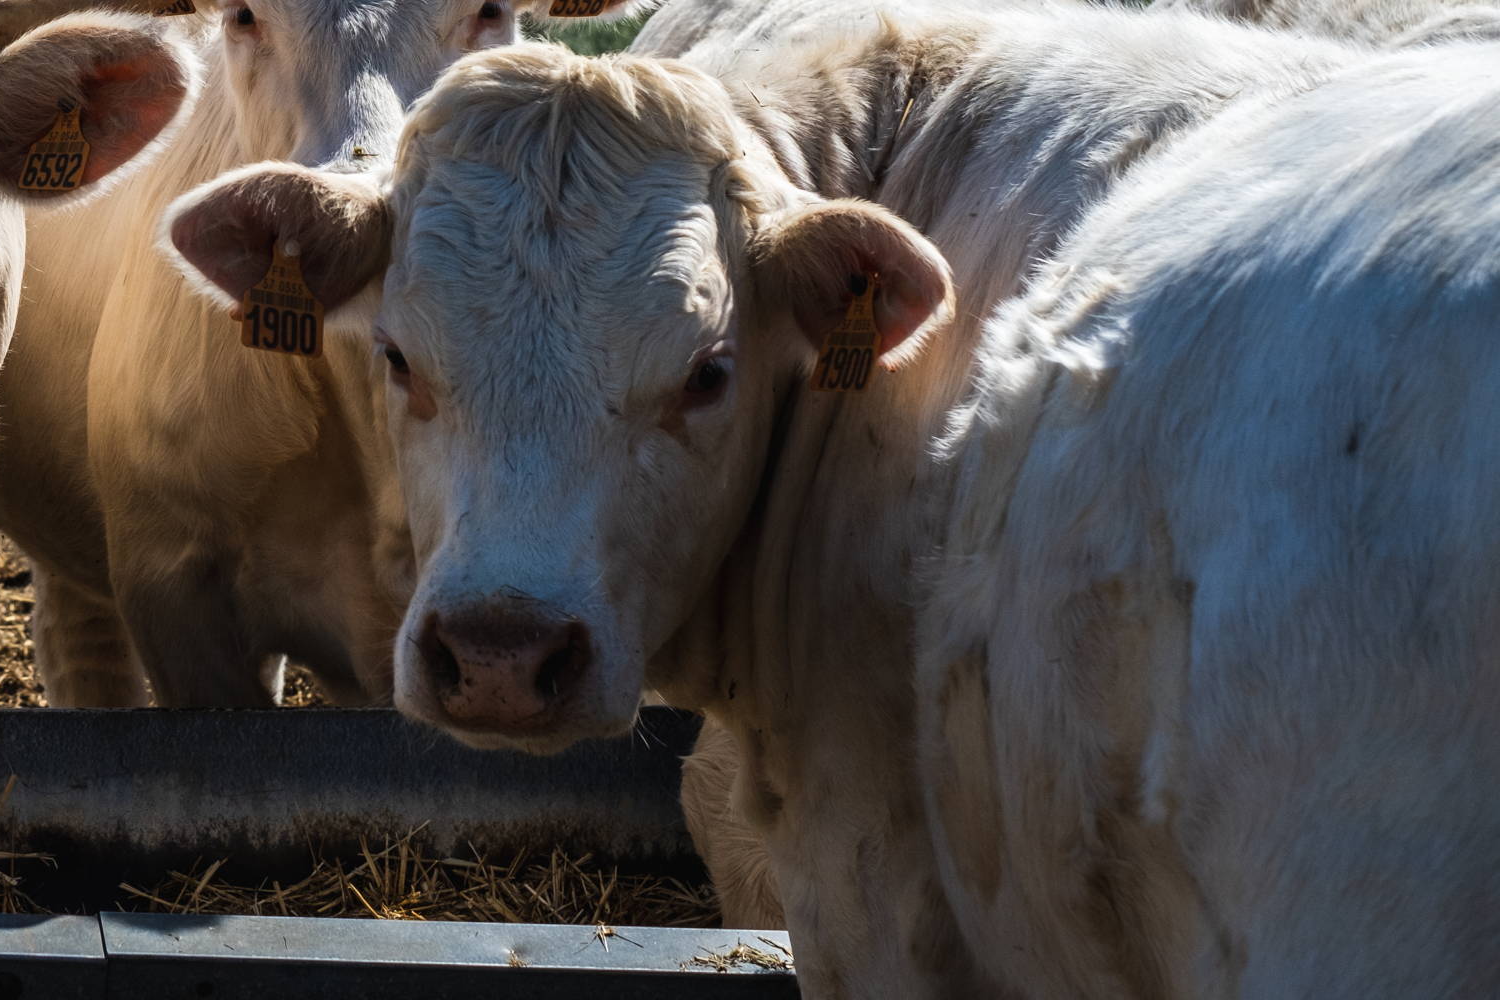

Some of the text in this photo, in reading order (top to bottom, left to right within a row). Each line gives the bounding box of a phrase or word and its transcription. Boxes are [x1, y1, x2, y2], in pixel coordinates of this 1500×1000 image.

[23, 152, 83, 188] 6592
[245, 304, 317, 354] 1900
[820, 346, 873, 390] 1900
